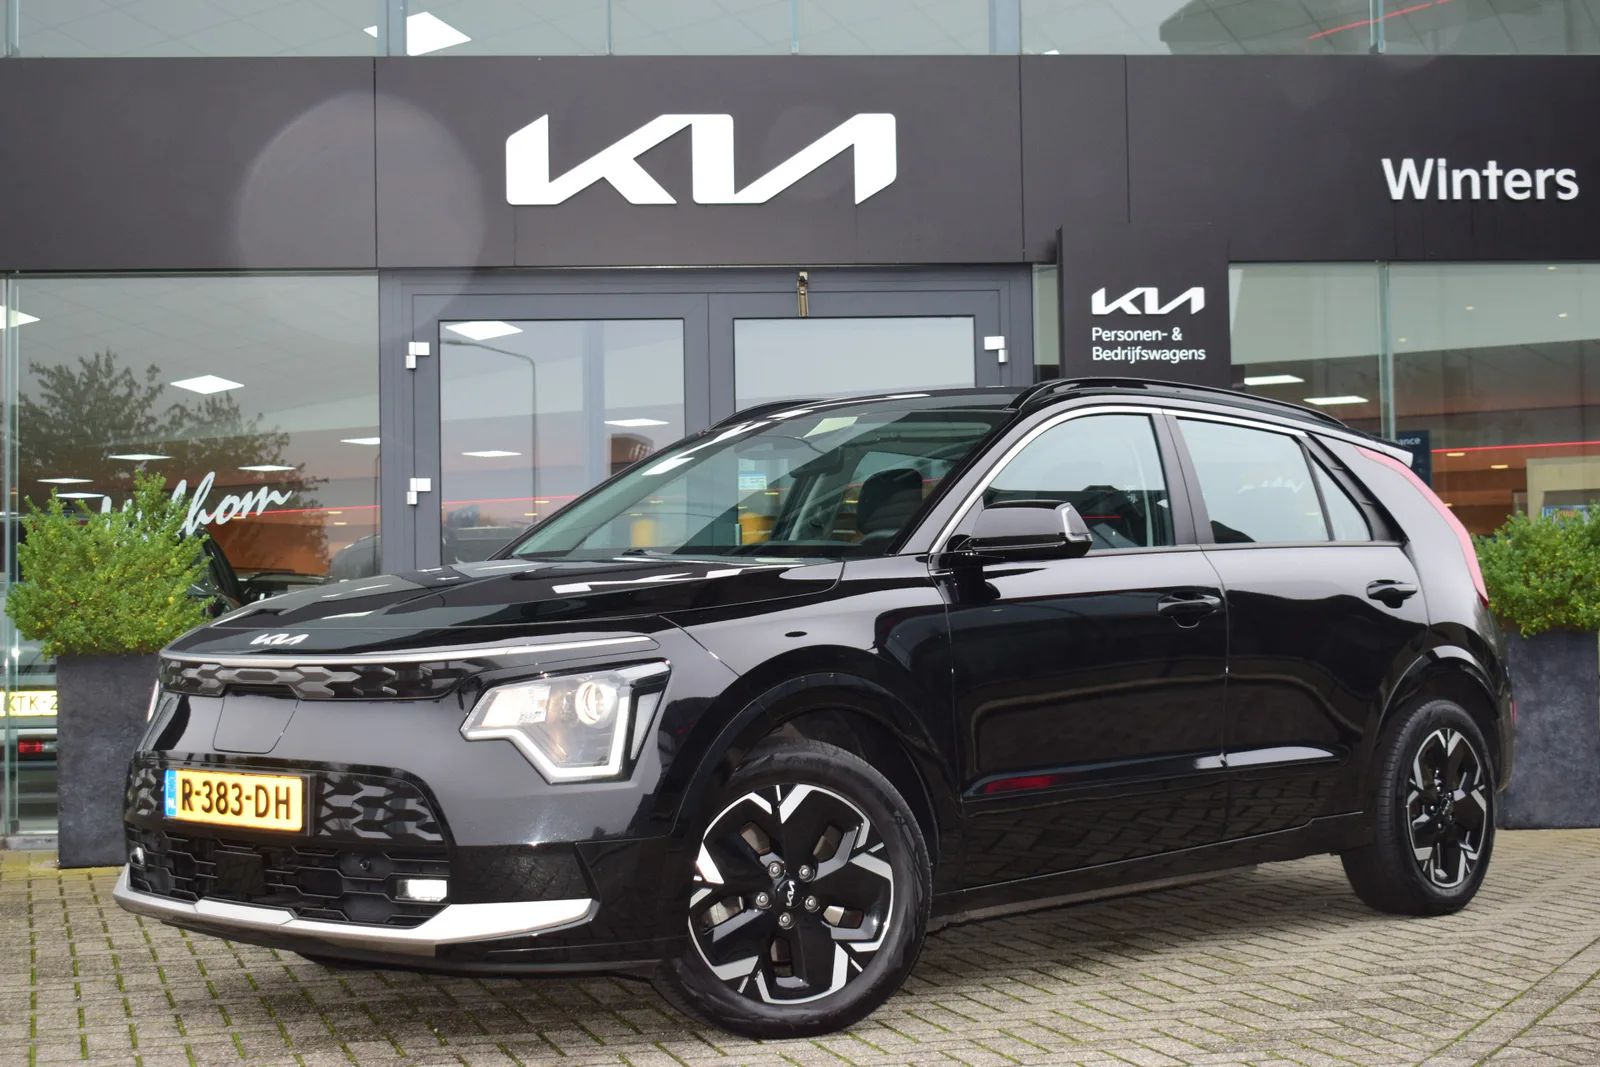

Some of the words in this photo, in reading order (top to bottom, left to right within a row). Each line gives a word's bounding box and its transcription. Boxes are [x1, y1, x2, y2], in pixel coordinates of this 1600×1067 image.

[506, 113, 897, 205] KIA
[1381, 158, 1580, 200] Winters
[1091, 287, 1205, 315] KIA
[1092, 327, 1168, 341] Personen-
[1172, 327, 1183, 341] &
[1092, 346, 1206, 364] Bedrijfswagens
[250, 633, 309, 645] KIA
[181, 778, 291, 820] R-383-DH
